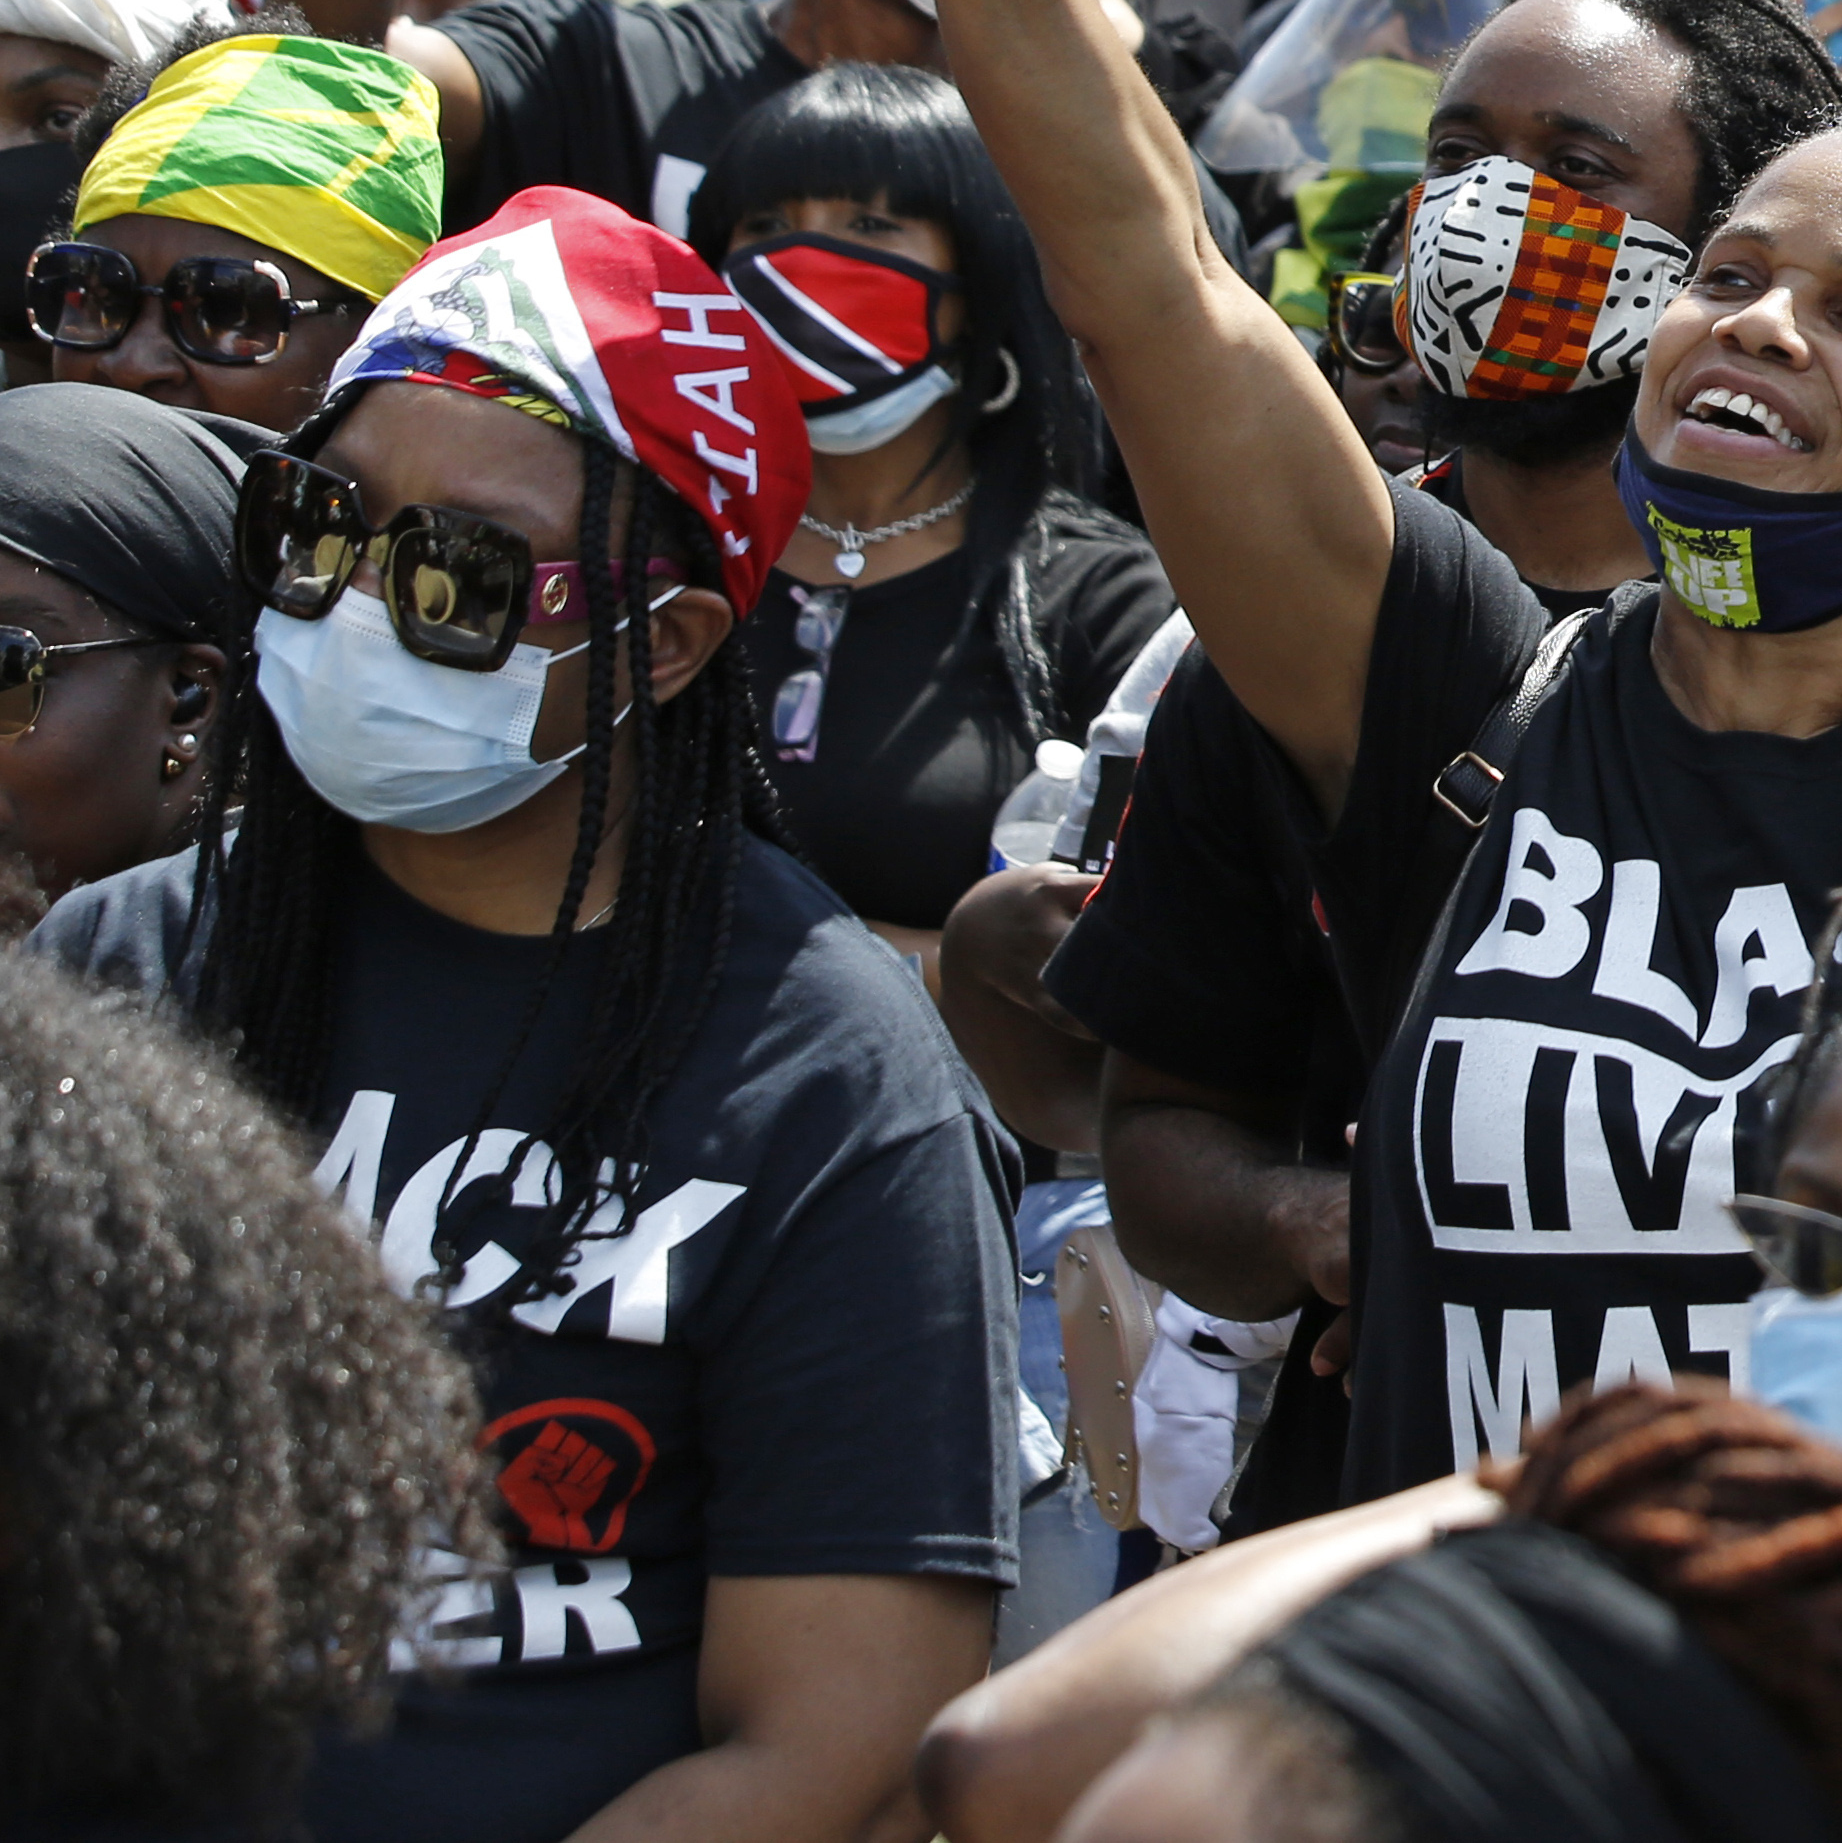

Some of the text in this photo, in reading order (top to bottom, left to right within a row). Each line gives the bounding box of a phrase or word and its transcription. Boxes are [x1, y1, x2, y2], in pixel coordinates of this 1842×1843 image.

[1664, 538, 1743, 589] LIFE
[1670, 564, 1748, 616] UP
[1420, 1038, 1755, 1233] LIV
